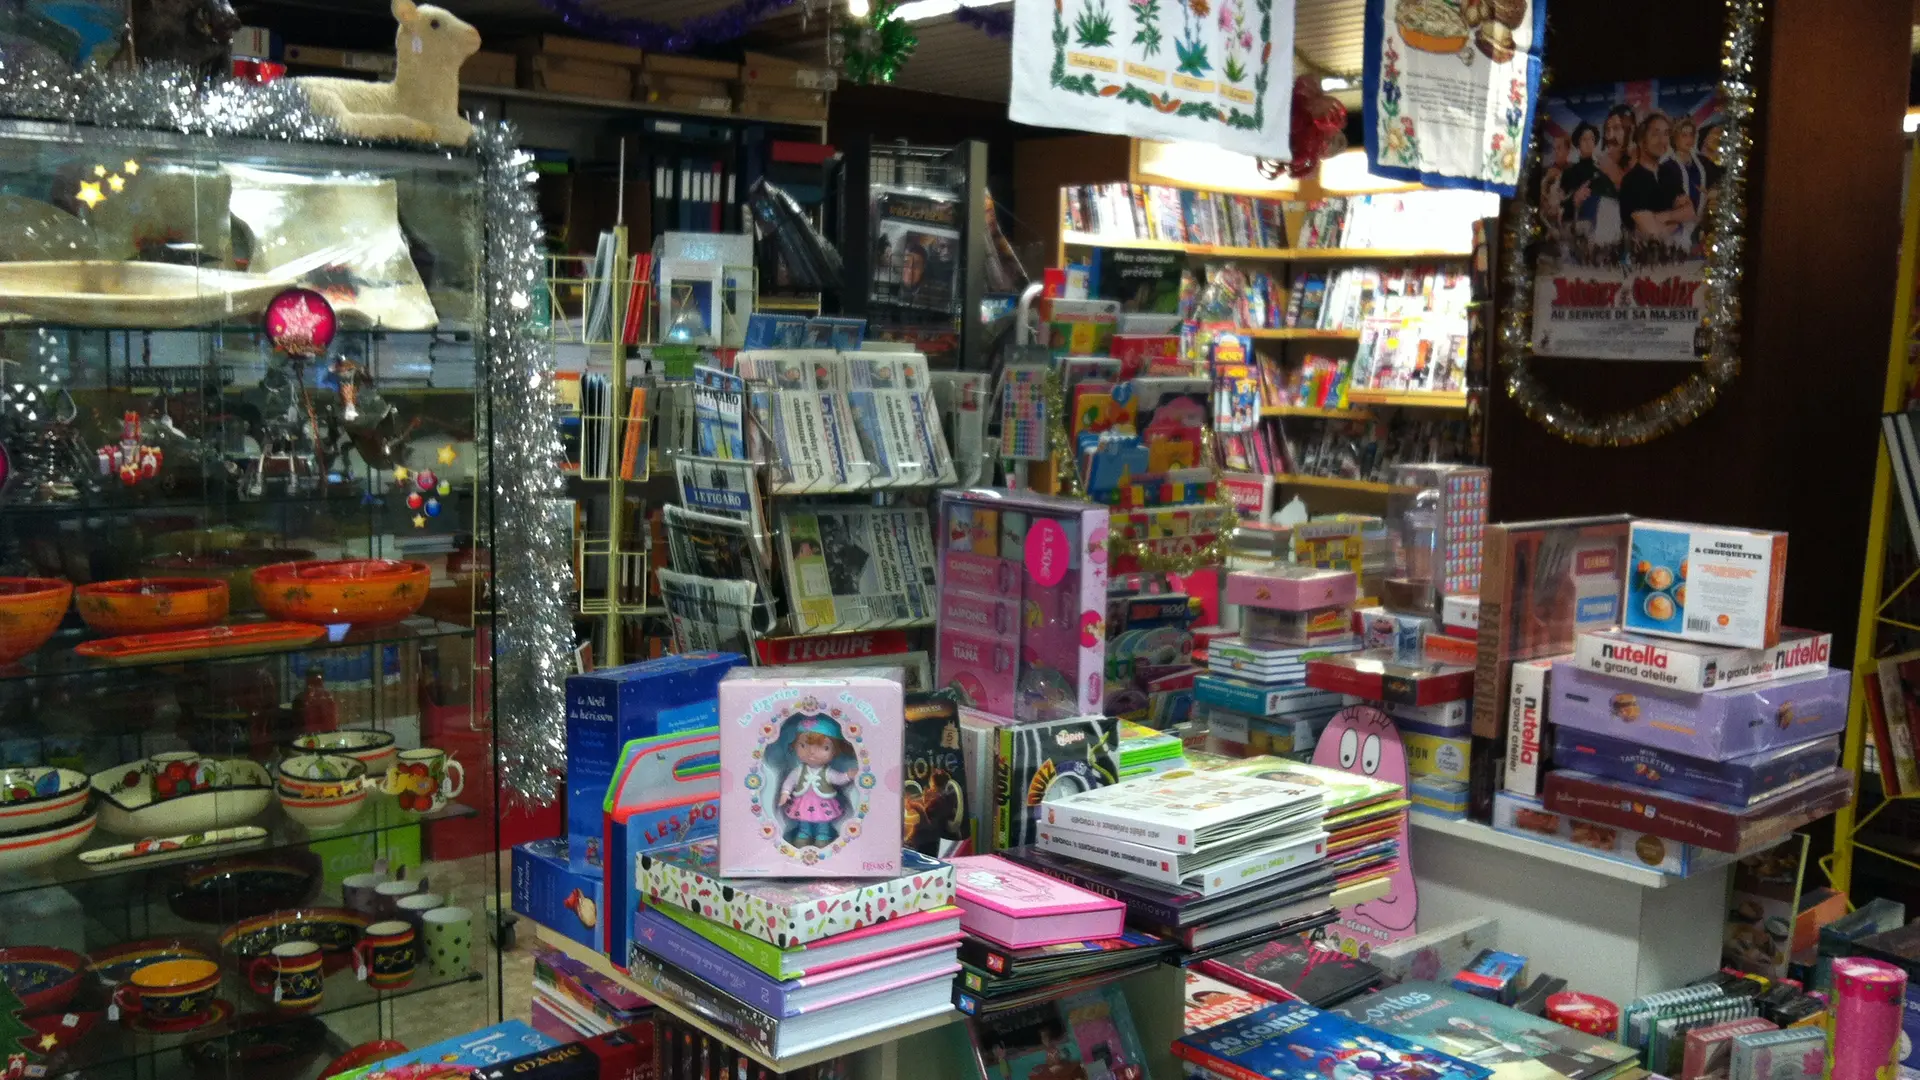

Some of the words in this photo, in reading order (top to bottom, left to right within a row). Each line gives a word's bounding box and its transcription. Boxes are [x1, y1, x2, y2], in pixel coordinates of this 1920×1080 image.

[1135, 253, 1175, 263] animaux
[1567, 309, 1611, 320] SERVICE
[1615, 309, 1629, 320] DE
[1632, 309, 1647, 320] SA
[703, 388, 739, 406] FIGARO
[706, 493, 742, 506] FIGARO
[1703, 548, 1763, 561] CHOUQUETTES
[952, 646, 979, 662] TIANA
[1602, 643, 1668, 669] nutella
[1775, 634, 1829, 670] nutella
[1591, 657, 1602, 668] le
[1603, 660, 1638, 677] grand
[1641, 668, 1678, 685] atelier
[1718, 669, 1726, 681] le
[1726, 665, 1749, 682] grand
[1750, 662, 1773, 676] atelier
[1515, 683, 1524, 694] le
[587, 695, 606, 707] Noël
[739, 714, 752, 727] La
[753, 688, 799, 713] figurine
[839, 691, 854, 703] de
[579, 708, 613, 722] hérisson
[1512, 697, 1523, 732] grand
[1520, 696, 1540, 766] nutella
[1509, 735, 1521, 772] atelier
[644, 815, 682, 845] LES
[1126, 898, 1171, 918] LAROUSSE
[1209, 1036, 1242, 1051] 40
[1239, 1007, 1320, 1040] CONTES
